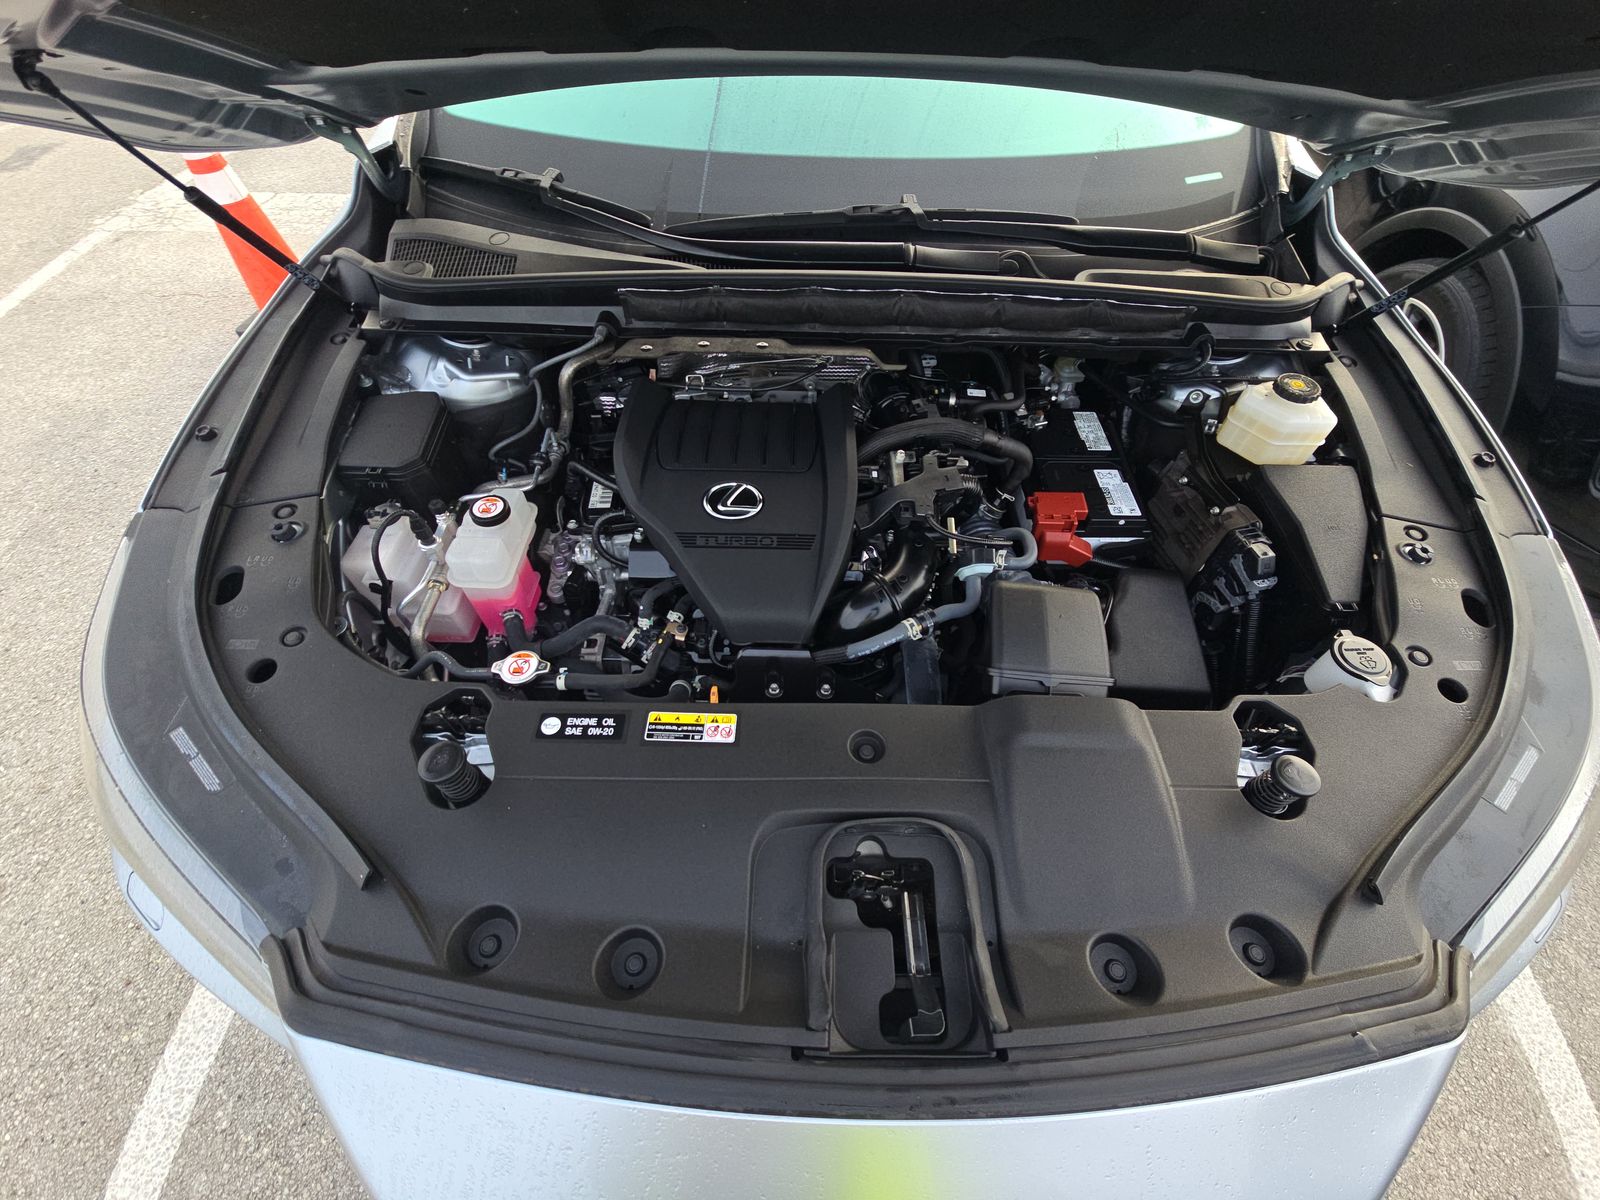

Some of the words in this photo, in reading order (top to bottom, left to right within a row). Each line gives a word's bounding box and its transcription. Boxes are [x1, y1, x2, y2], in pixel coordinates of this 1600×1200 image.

[700, 535, 775, 547] TURBO
[566, 717, 599, 726] ENGINE
[602, 717, 616, 726] OIL
[564, 727, 583, 736] SAE
[587, 727, 615, 736] 0W-20
